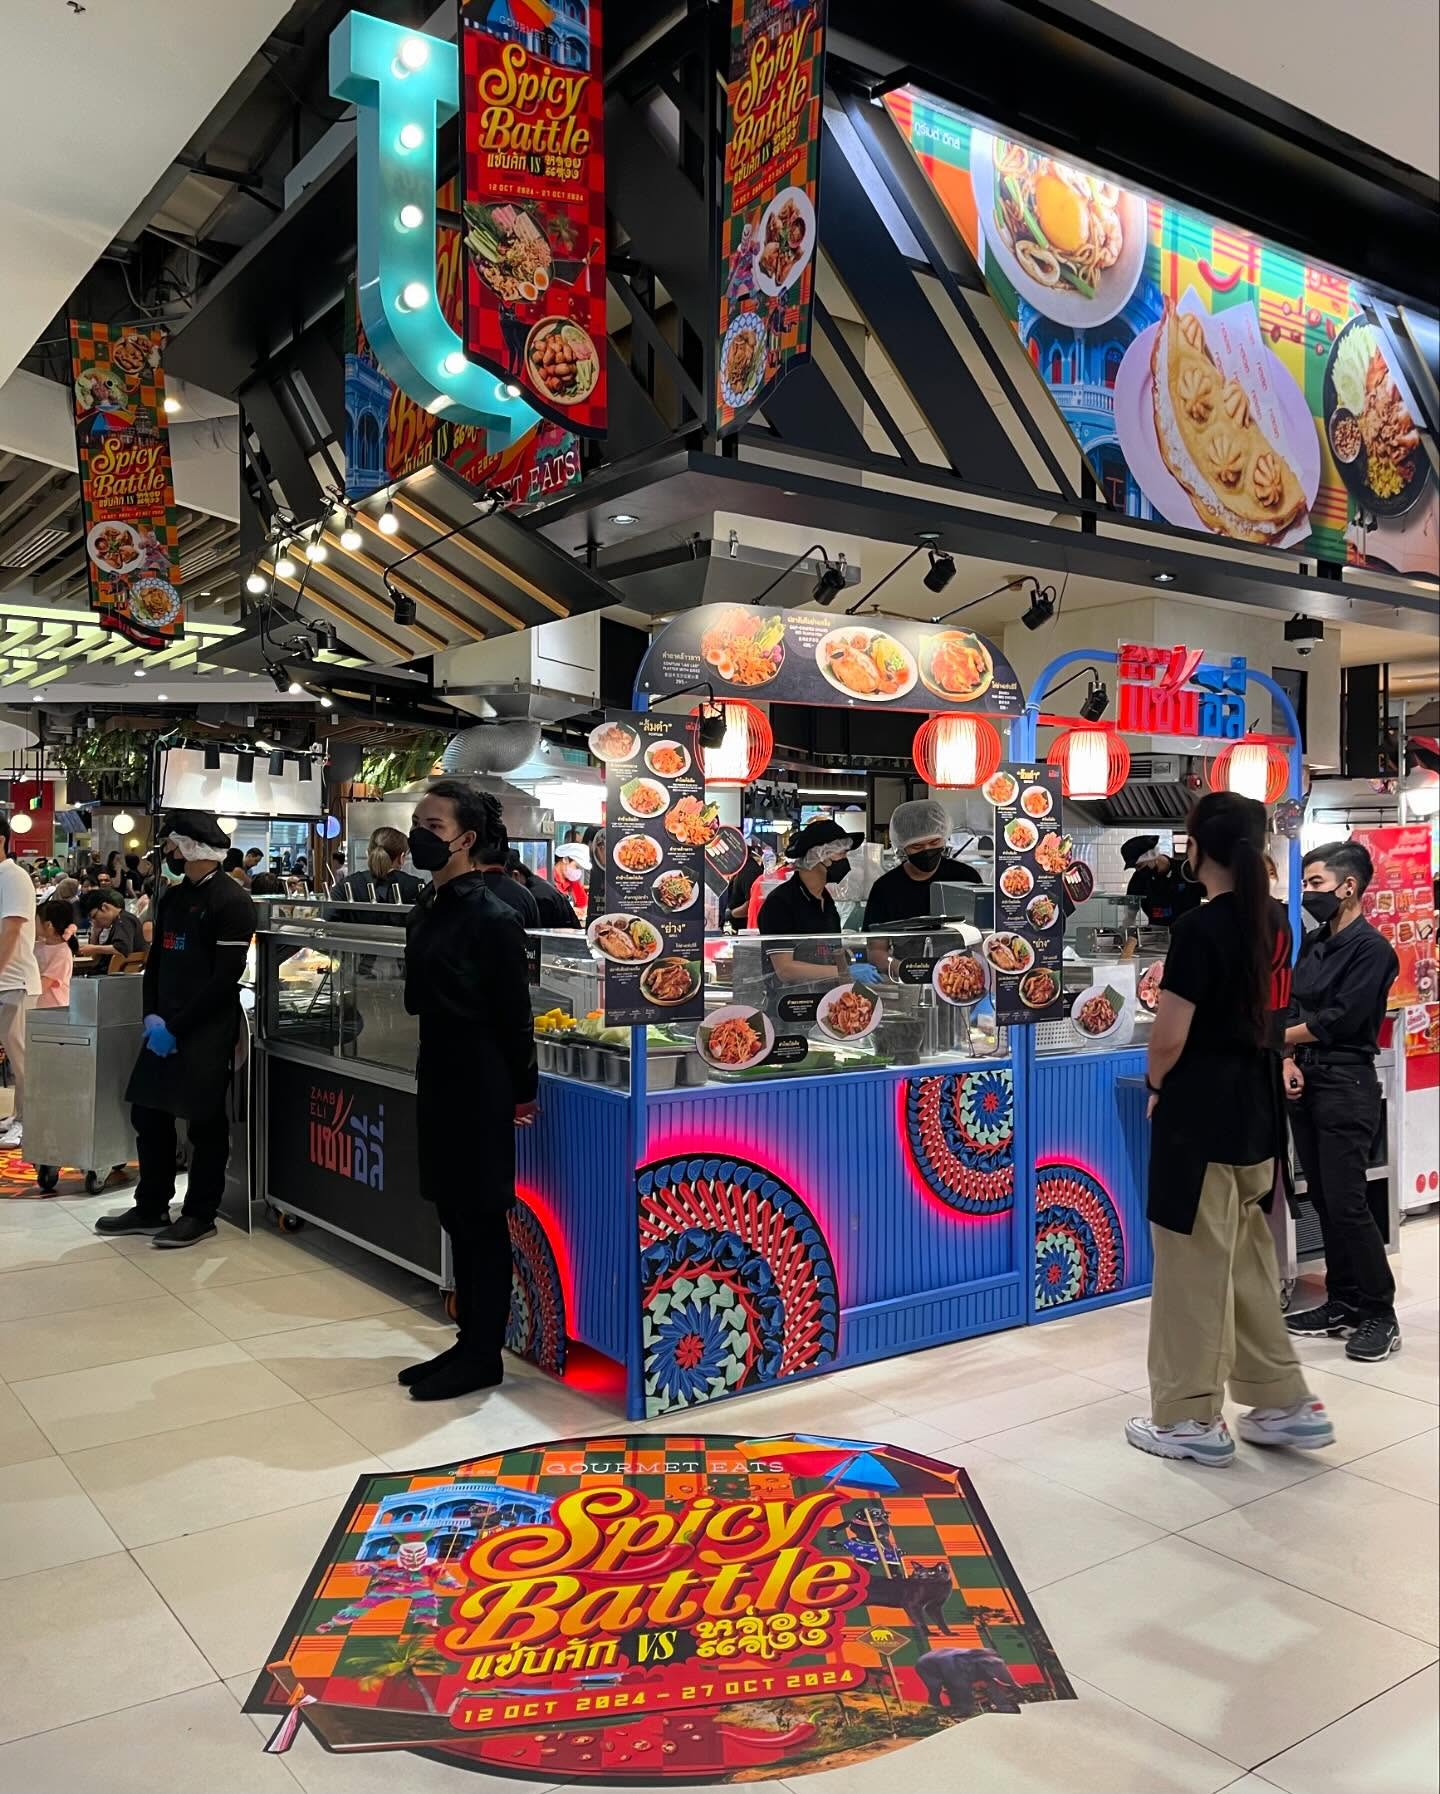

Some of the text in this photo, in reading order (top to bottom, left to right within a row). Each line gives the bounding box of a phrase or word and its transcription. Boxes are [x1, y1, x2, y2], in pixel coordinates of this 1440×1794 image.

[478, 43, 590, 120] Spicy
[734, 12, 813, 123] Spicy
[478, 106, 590, 155] Battle
[731, 68, 807, 170] Battle
[92, 438, 163, 475] Spicy
[529, 450, 576, 497] EATS
[93, 468, 166, 498] Battle
[311, 1086, 336, 1105] ZAAB
[311, 1102, 327, 1120] ELI
[546, 1460, 784, 1475] GOURMET EATS
[469, 1486, 846, 1579] Spicy
[445, 1547, 852, 1650] Battle
[637, 1629, 680, 1663] VS
[465, 1707, 494, 1723] 12
[504, 1701, 558, 1718] OCT
[576, 1693, 647, 1712] 2024
[682, 1685, 715, 1699] 27
[725, 1678, 775, 1696] OCT
[786, 1670, 854, 1688] 2024
